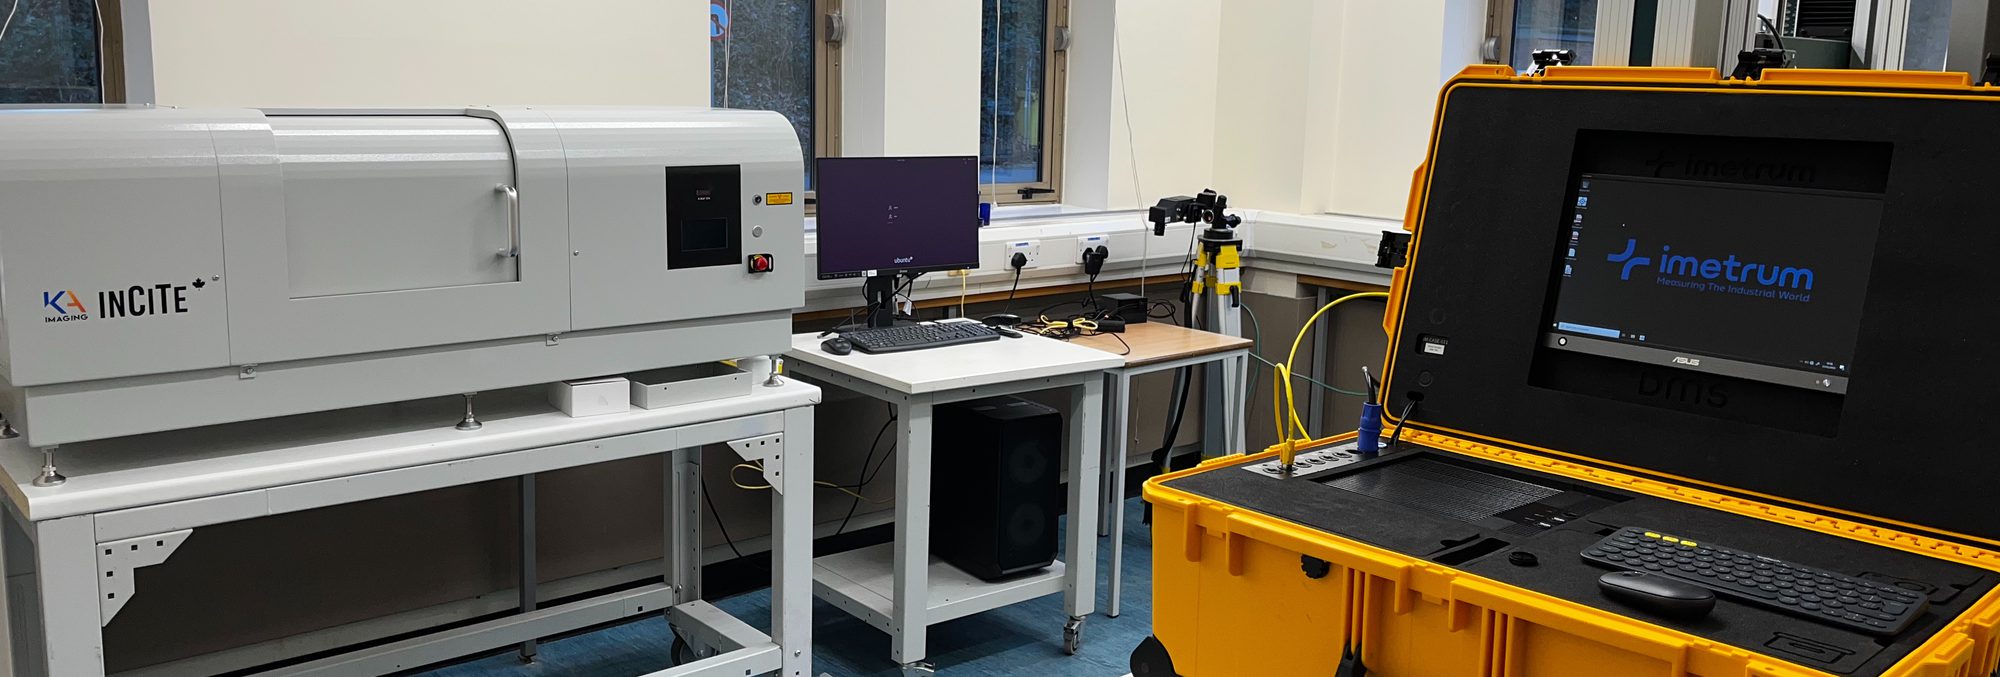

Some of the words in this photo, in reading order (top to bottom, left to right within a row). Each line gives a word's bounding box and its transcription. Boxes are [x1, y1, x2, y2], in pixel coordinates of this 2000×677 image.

[1685, 153, 1816, 183] imetrum
[894, 256, 912, 264] ubuntu
[1659, 245, 1814, 290] imetrum
[1656, 277, 1705, 292] Measuring
[1707, 282, 1726, 293] The
[1728, 285, 1775, 299] Industrial
[1778, 290, 1810, 302] World
[43, 290, 87, 314] KA
[45, 314, 88, 323] IMAGING
[1672, 356, 1700, 367] ASUS
